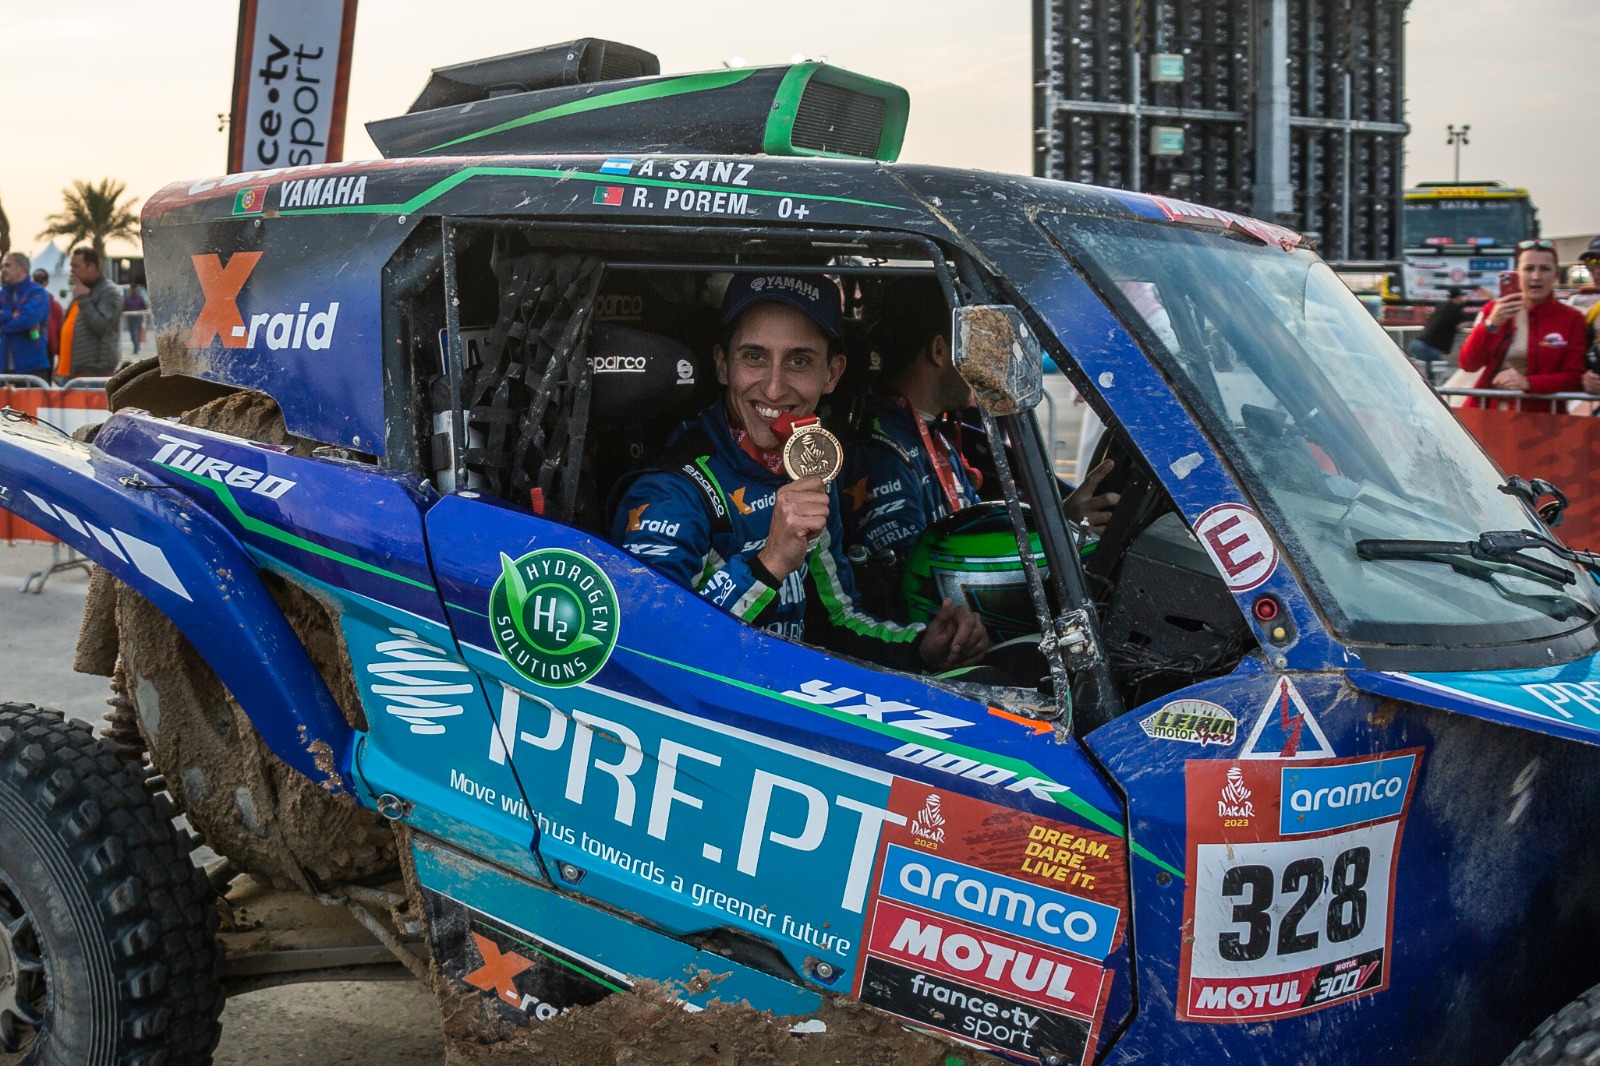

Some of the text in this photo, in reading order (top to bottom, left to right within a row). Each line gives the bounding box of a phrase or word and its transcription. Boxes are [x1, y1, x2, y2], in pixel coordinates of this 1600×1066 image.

[288, 43, 325, 166] sport
[279, 175, 368, 207] YAMAHA
[664, 188, 749, 215] POREM
[187, 250, 340, 351] X-raid
[766, 276, 820, 300] YAMAHA
[595, 294, 643, 320] parco
[682, 464, 725, 518] sparco
[866, 520, 900, 541] VISITE
[1203, 514, 1266, 578] E
[526, 559, 609, 633] HYDROGEN
[496, 614, 588, 681] SOLUTIONS
[780, 679, 976, 741] YXZ
[1155, 711, 1235, 736] LEIRIA
[1154, 725, 1196, 741] motor
[487, 679, 908, 916] PRF.PT
[1218, 800, 1255, 818] DAKAR
[1290, 776, 1402, 812] aramco
[911, 820, 945, 844] DAKAR
[1224, 818, 1250, 828] 2023
[914, 837, 939, 850] 2023
[1025, 841, 1087, 871] DARE.
[1028, 825, 1110, 860] DREAM.
[450, 768, 852, 957] Move with us towards a greener future
[1021, 857, 1096, 890] LIVE IT.
[899, 862, 1098, 943] aramco
[1218, 846, 1371, 962] 328
[889, 917, 1076, 1003] MOTUL
[1335, 960, 1357, 972] MOTUL
[1195, 979, 1303, 1011] MOTUL
[1314, 960, 1380, 1002] 300V
[963, 1015, 1034, 1049] sport
